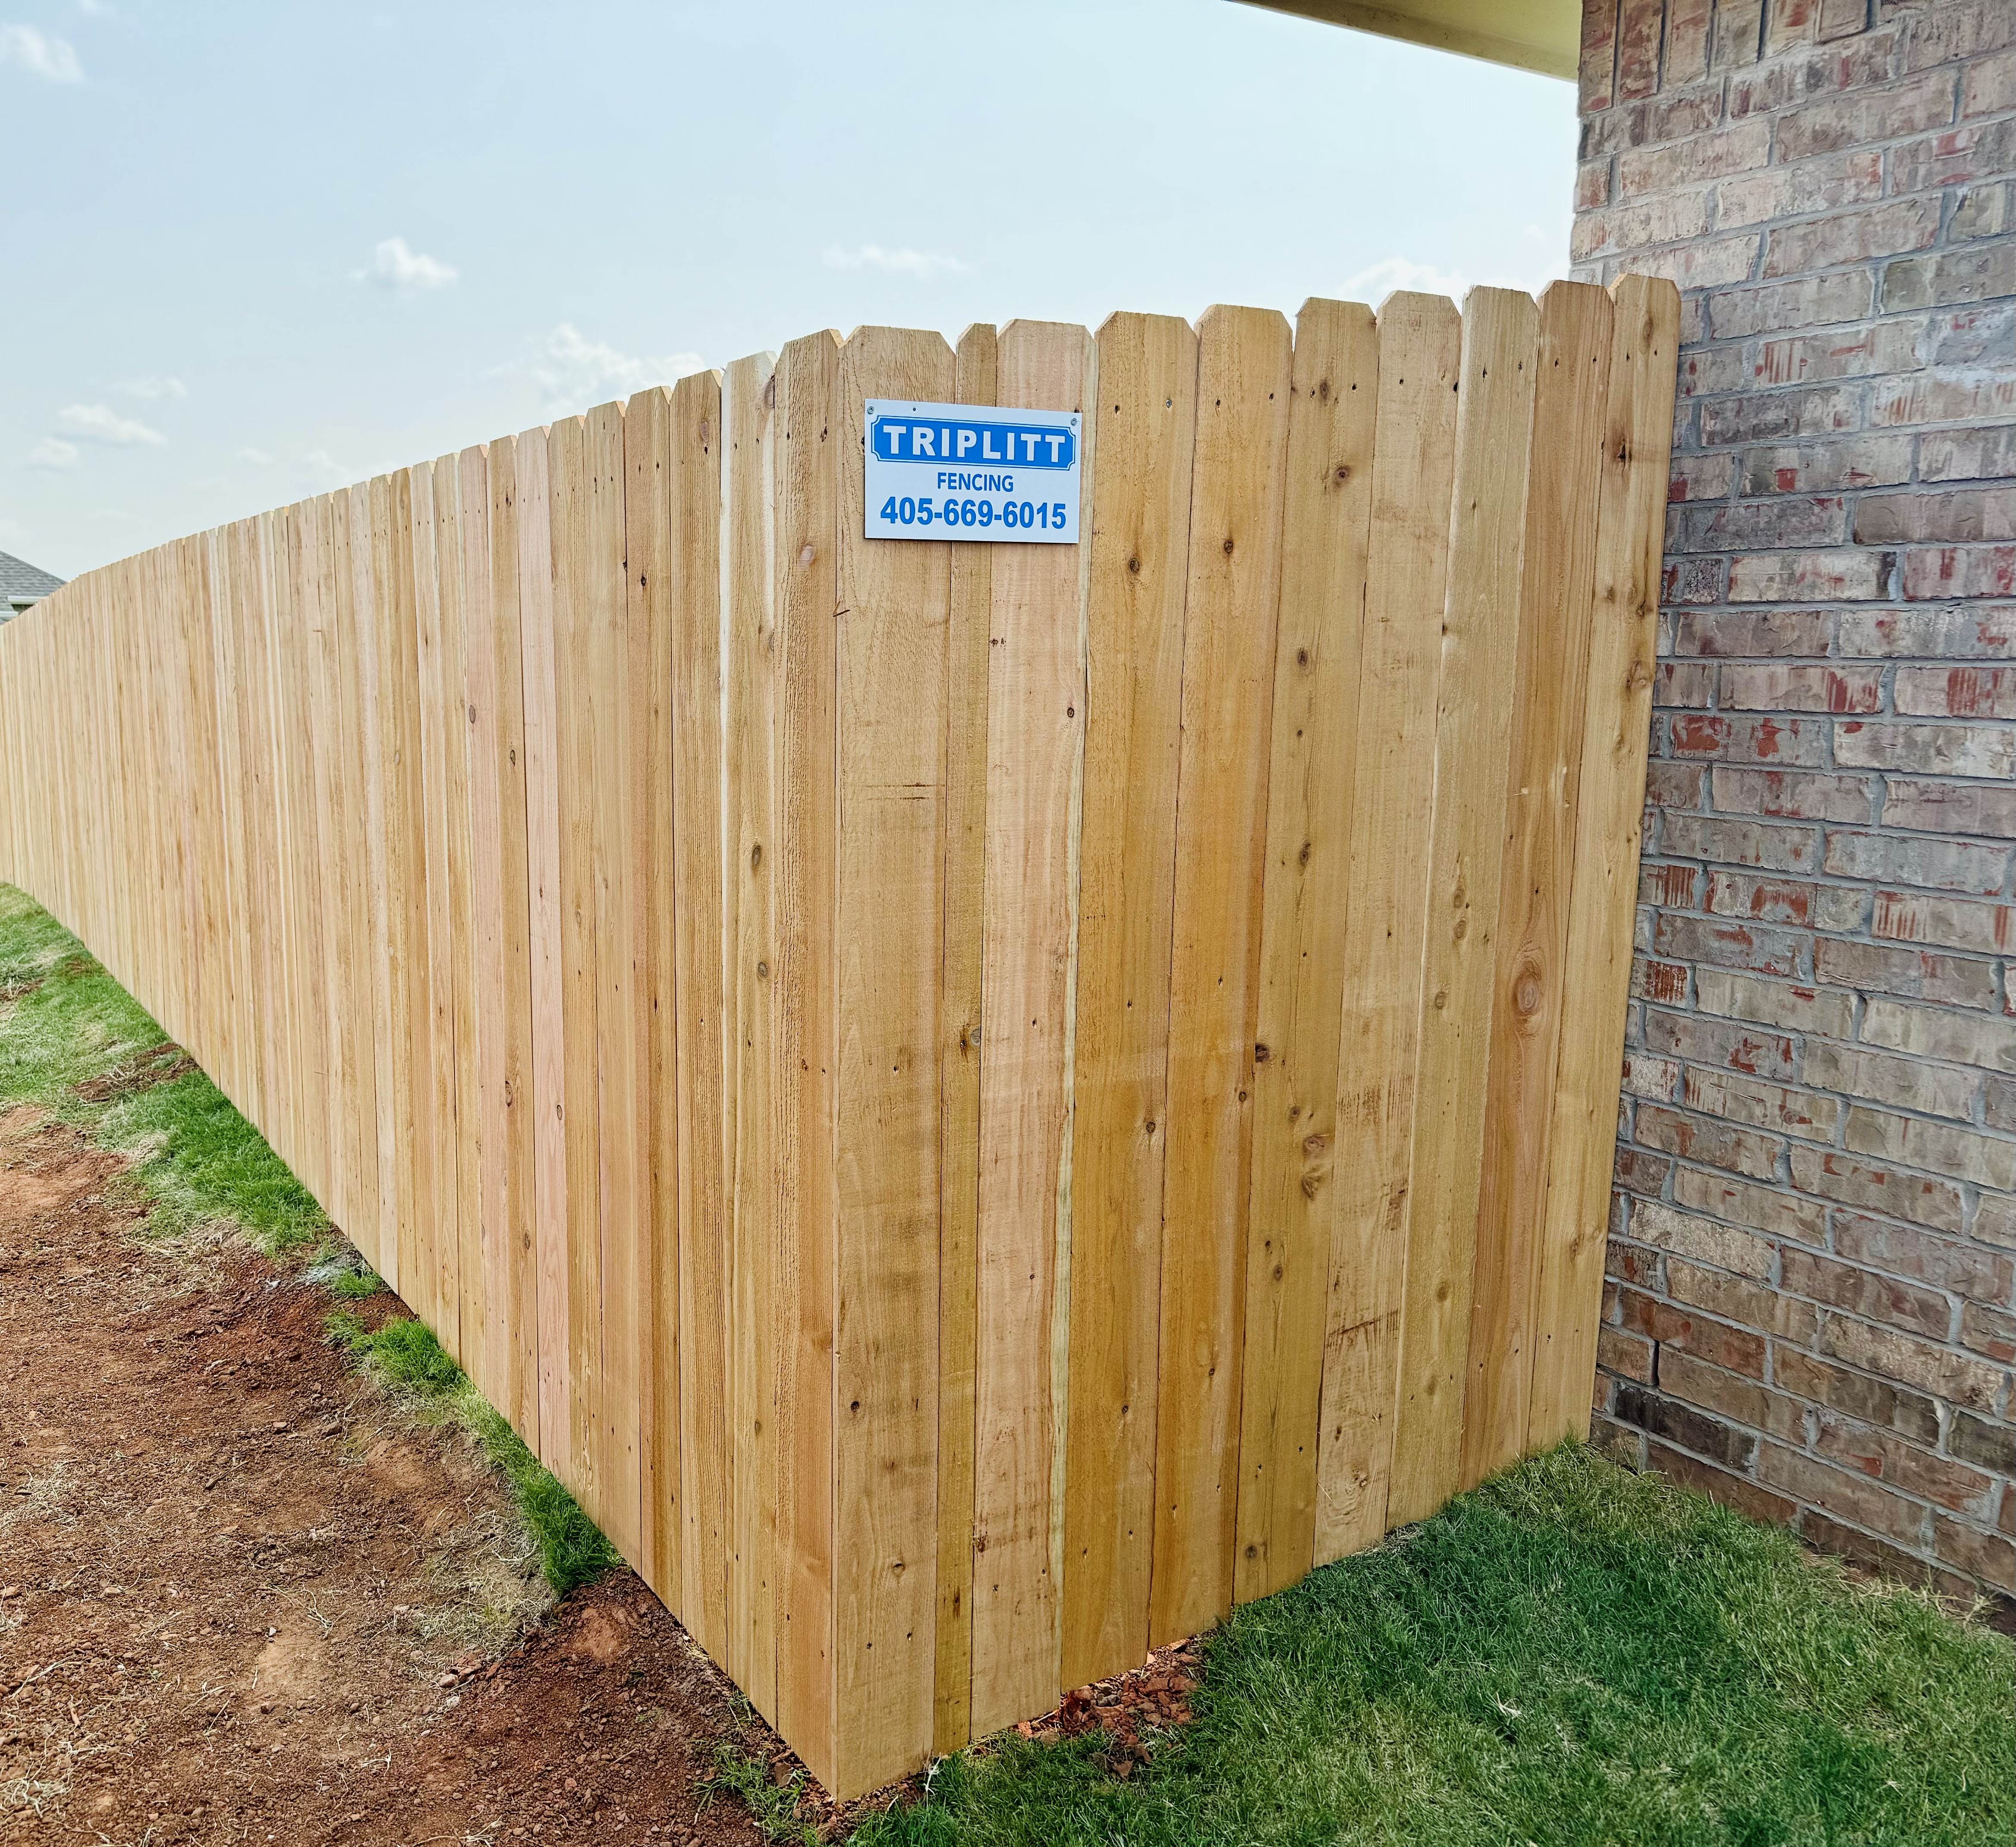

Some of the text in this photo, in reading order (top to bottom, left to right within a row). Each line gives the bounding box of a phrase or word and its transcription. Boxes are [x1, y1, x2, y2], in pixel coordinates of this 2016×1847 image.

[883, 425, 1065, 463] TRIPLITT
[937, 472, 1013, 492] FENCING
[880, 496, 1066, 529] 405-669-6015
